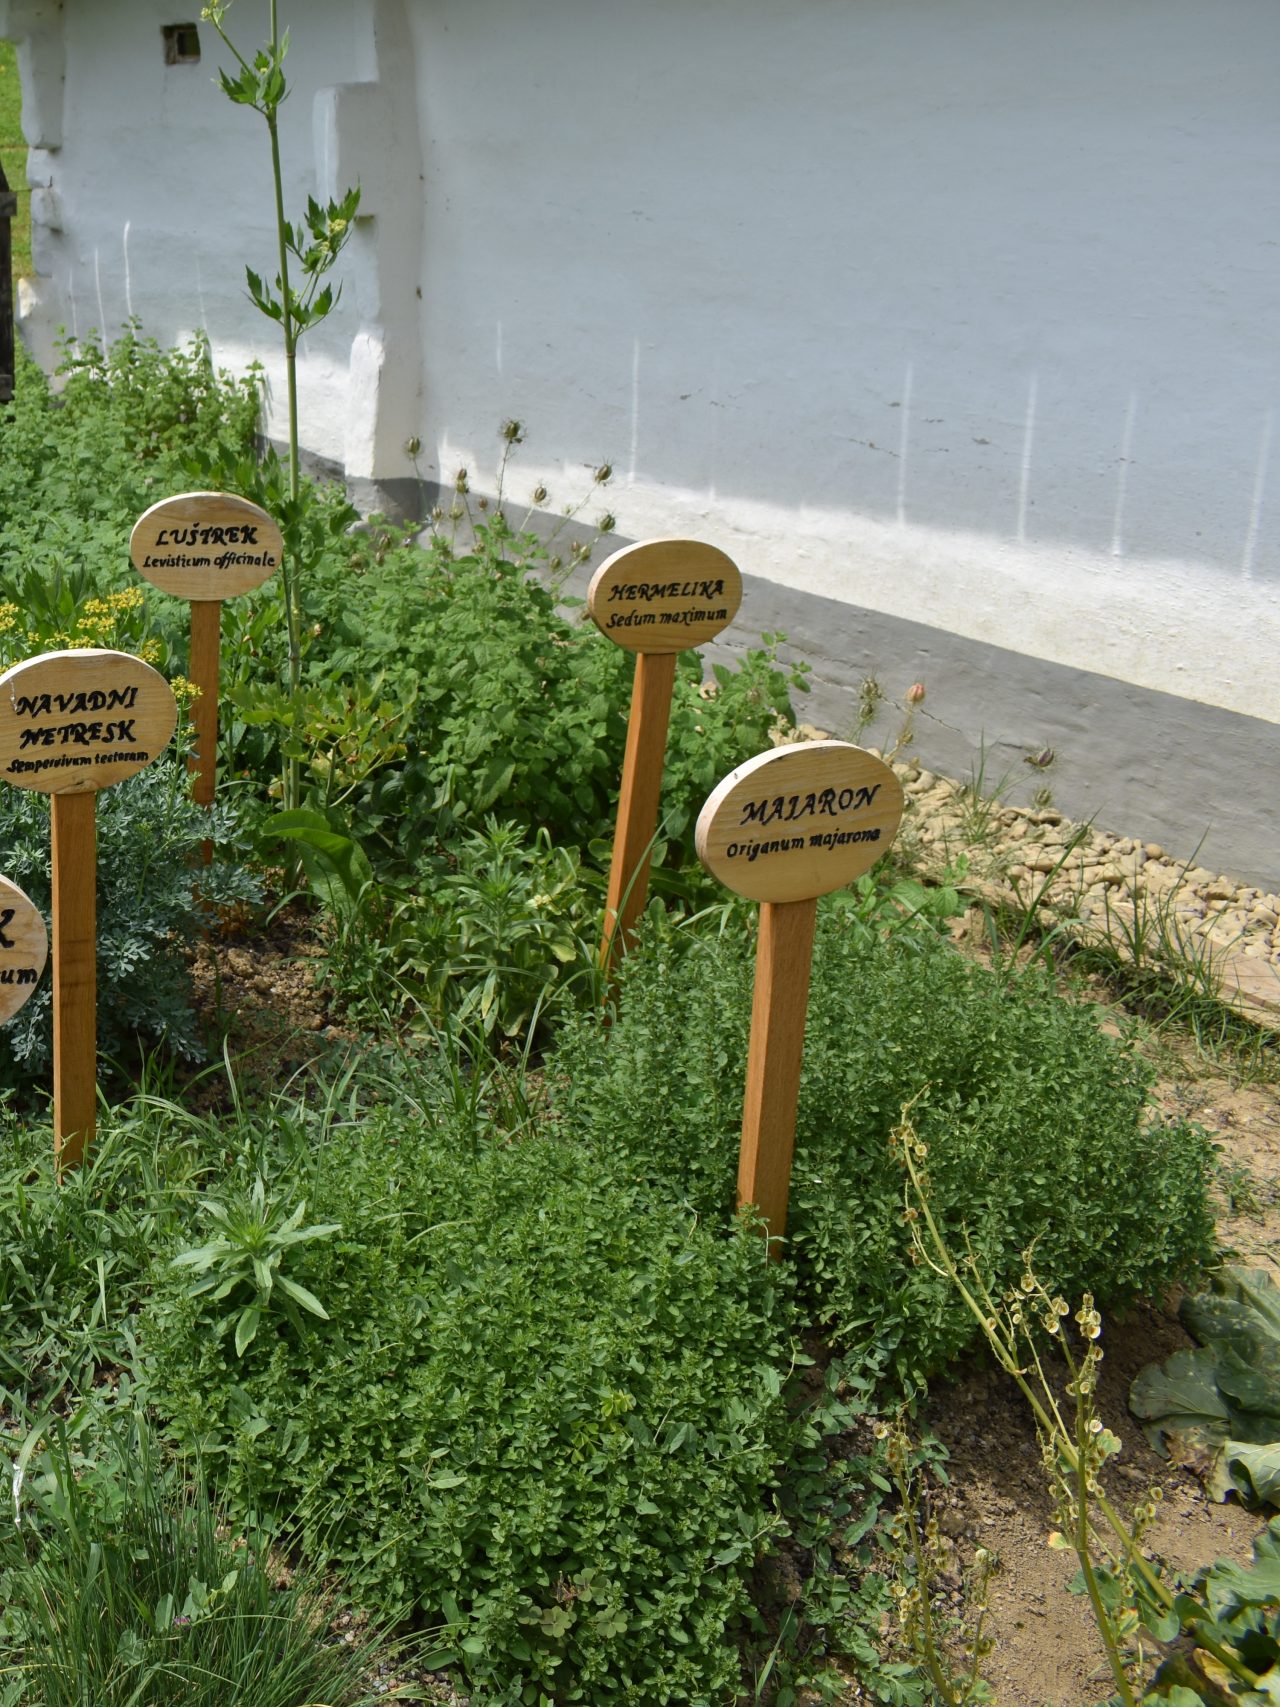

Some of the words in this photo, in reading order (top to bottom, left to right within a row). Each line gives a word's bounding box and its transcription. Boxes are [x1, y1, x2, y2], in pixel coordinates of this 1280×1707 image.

[155, 521, 259, 547] LUŠTREK
[142, 553, 211, 568] Levisticum
[213, 550, 277, 569] officinale
[607, 578, 725, 602] HERMELIKA
[605, 608, 657, 629] Sedum
[659, 606, 728, 626] maximum
[15, 684, 139, 719] NAVADNI
[19, 718, 137, 750] NETRESK
[5, 753, 92, 774] Sempervivum
[94, 750, 149, 765] tectorum
[739, 783, 882, 826] MAJARON
[726, 836, 805, 862] Origanum
